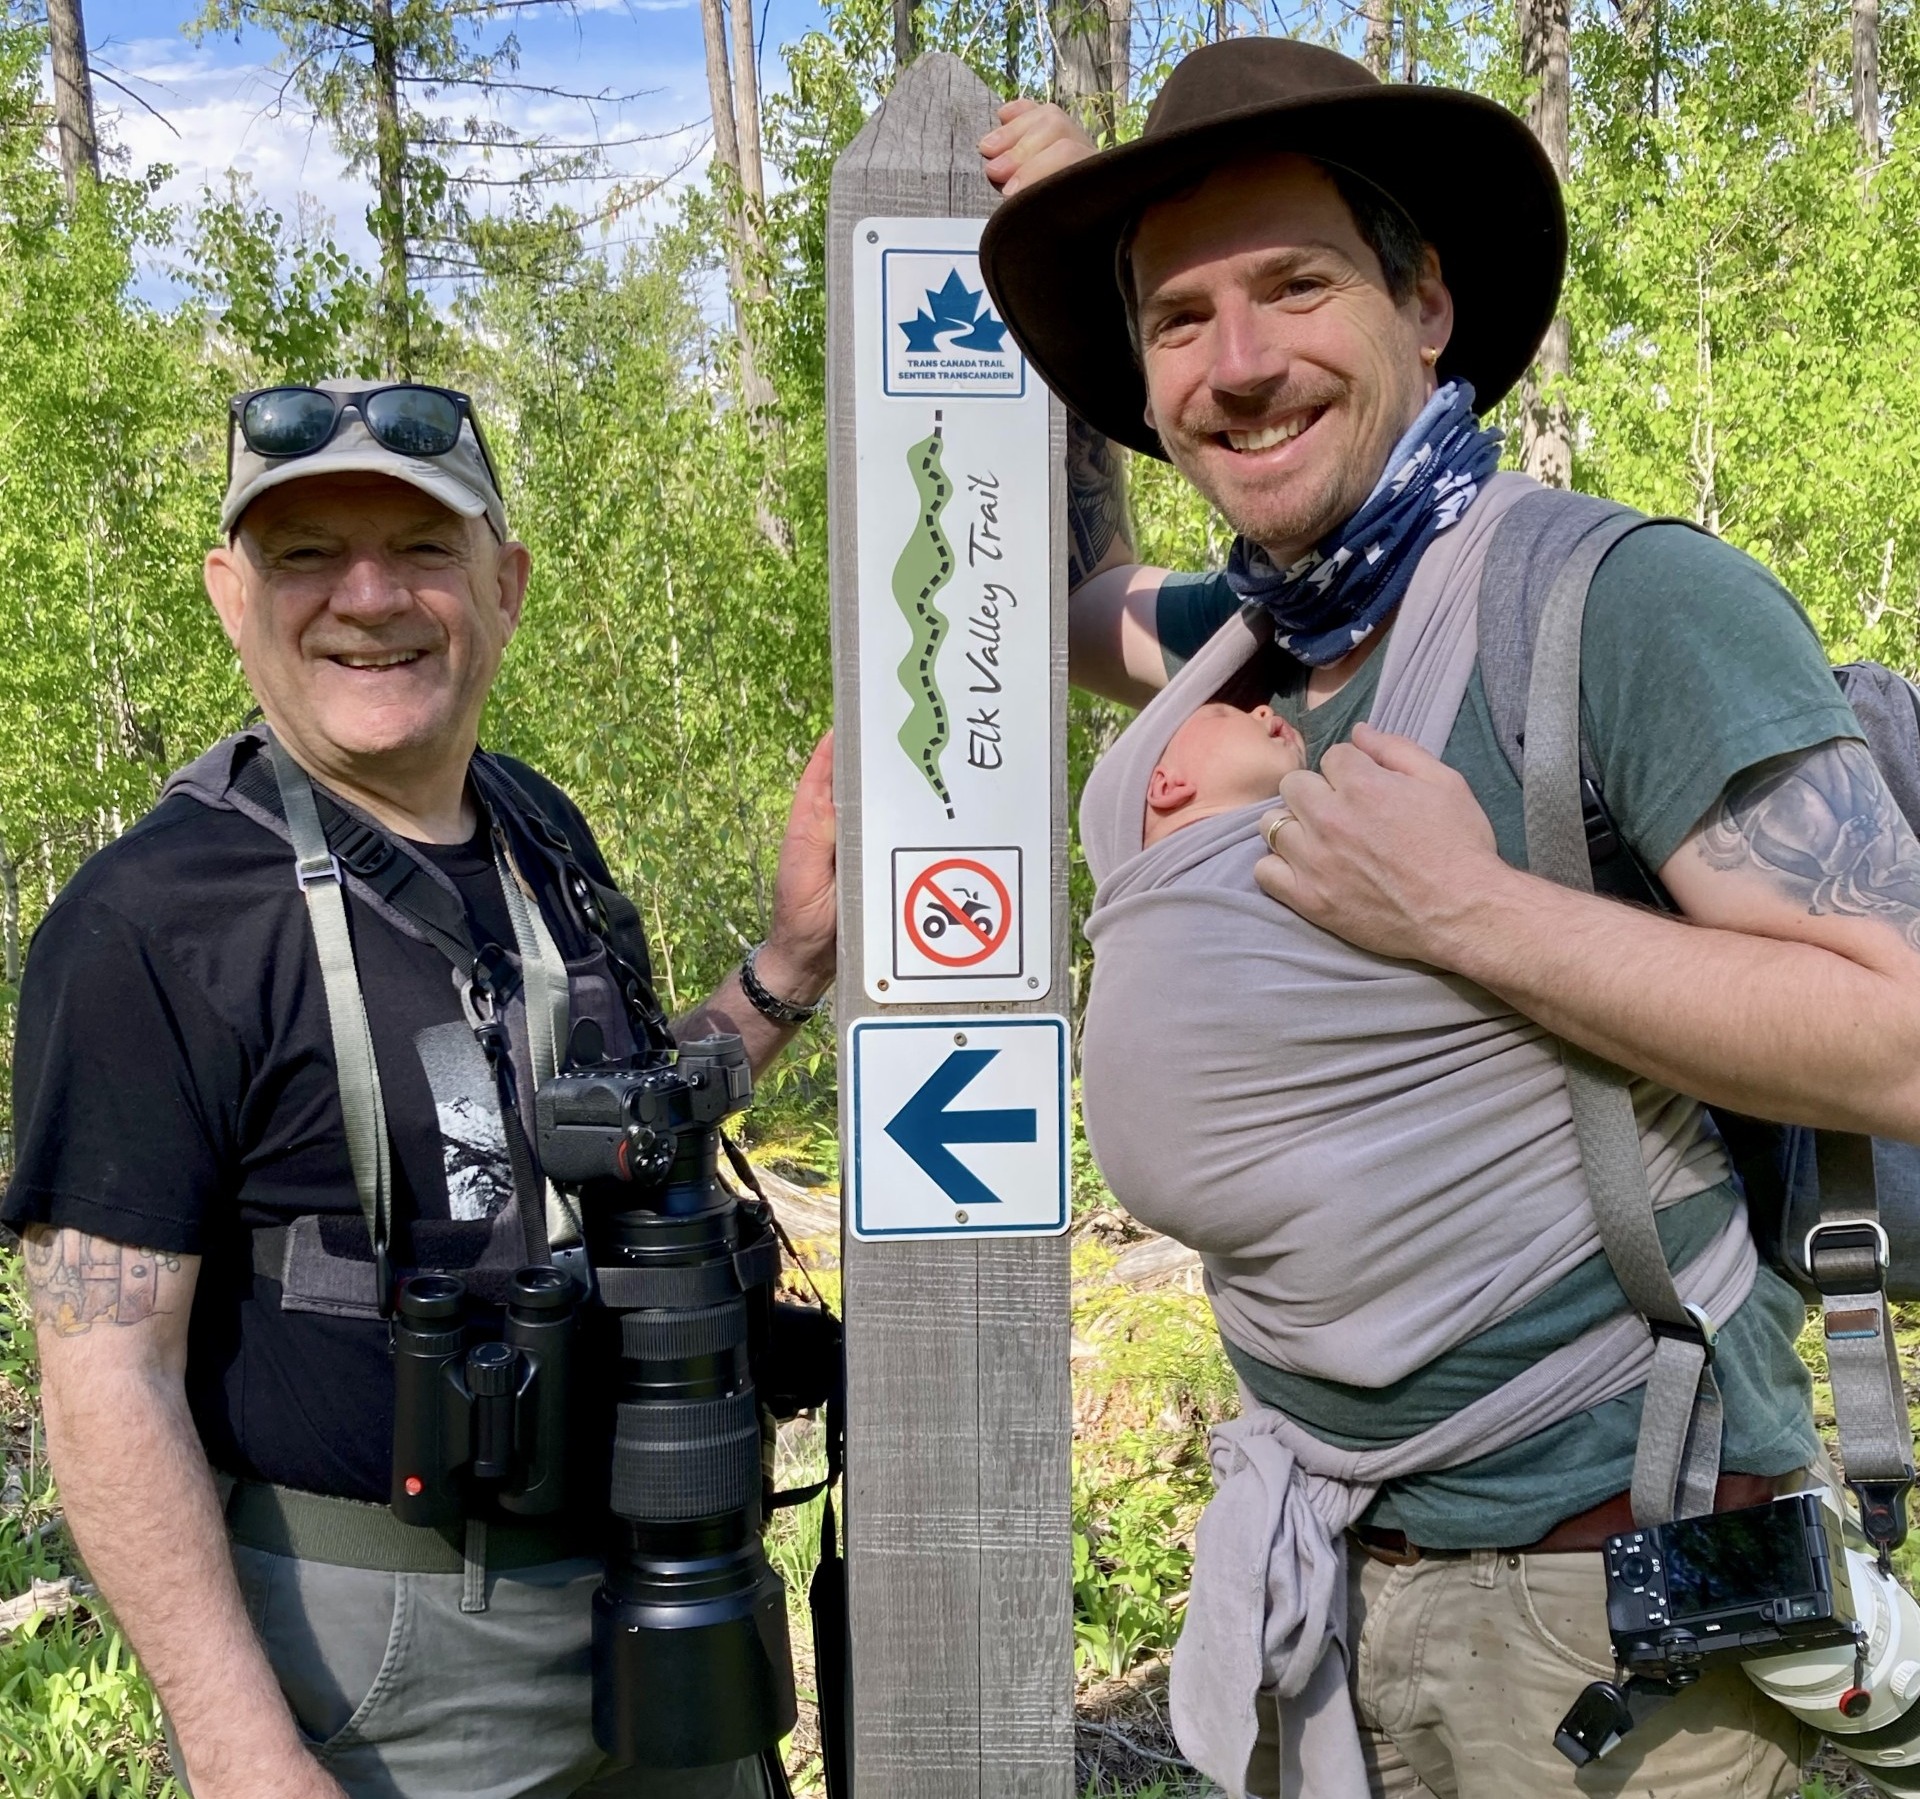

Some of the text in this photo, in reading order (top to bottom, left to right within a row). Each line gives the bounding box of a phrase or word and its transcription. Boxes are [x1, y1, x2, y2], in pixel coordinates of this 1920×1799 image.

[907, 359, 1005, 368] TRANS CANADA TRAIL
[898, 371, 1014, 380] SENTIER TRANSCANADIEN
[965, 469, 1018, 770] Elk Valley Trail
